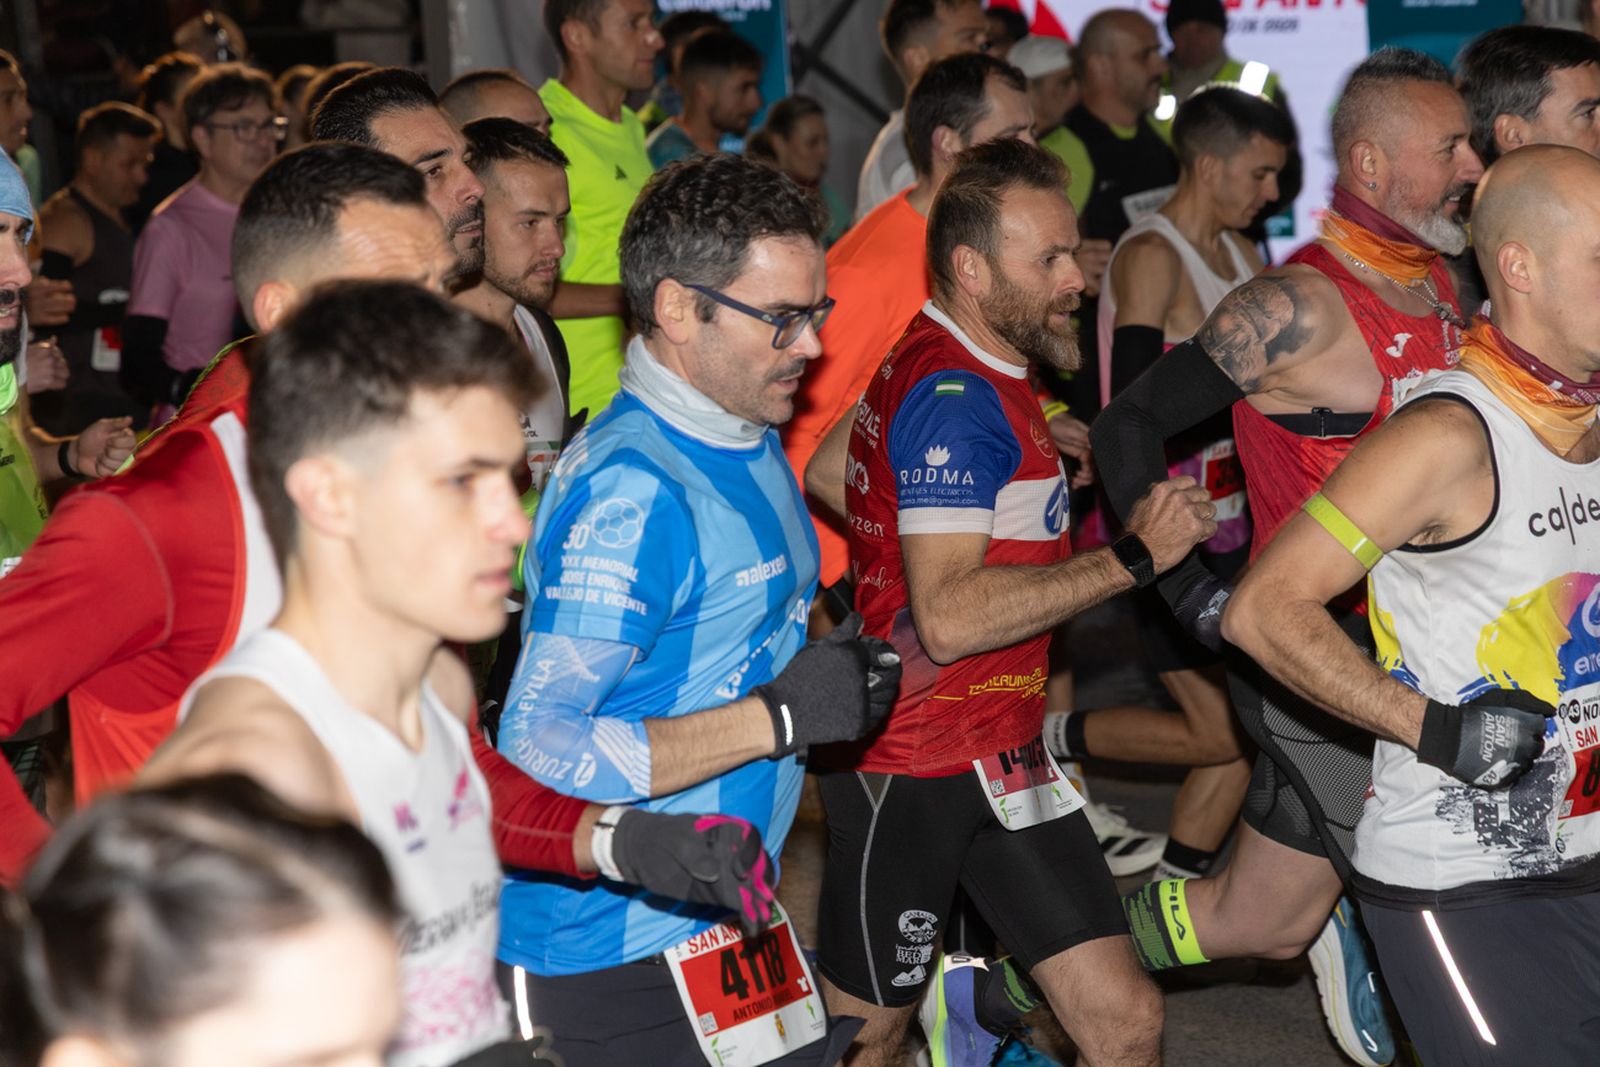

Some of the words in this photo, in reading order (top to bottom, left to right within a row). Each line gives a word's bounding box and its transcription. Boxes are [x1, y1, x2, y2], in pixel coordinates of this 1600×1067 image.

[900, 467, 974, 485] RODMA
[562, 523, 591, 550] 30
[560, 555, 579, 568] XXX
[581, 556, 639, 583] MEMORIAL
[560, 570, 587, 585] JOSE
[587, 571, 632, 594] ENRIQUE
[545, 586, 585, 600] VALLEJO
[585, 589, 600, 604] DE
[603, 592, 648, 616] VICENTE
[1482, 711, 1497, 763] ANTÓN
[1495, 715, 1506, 747] SAN
[1575, 725, 1599, 748] SAN
[515, 735, 574, 780] ZURICH
[687, 928, 721, 955] SAN
[719, 931, 787, 1002] 4118
